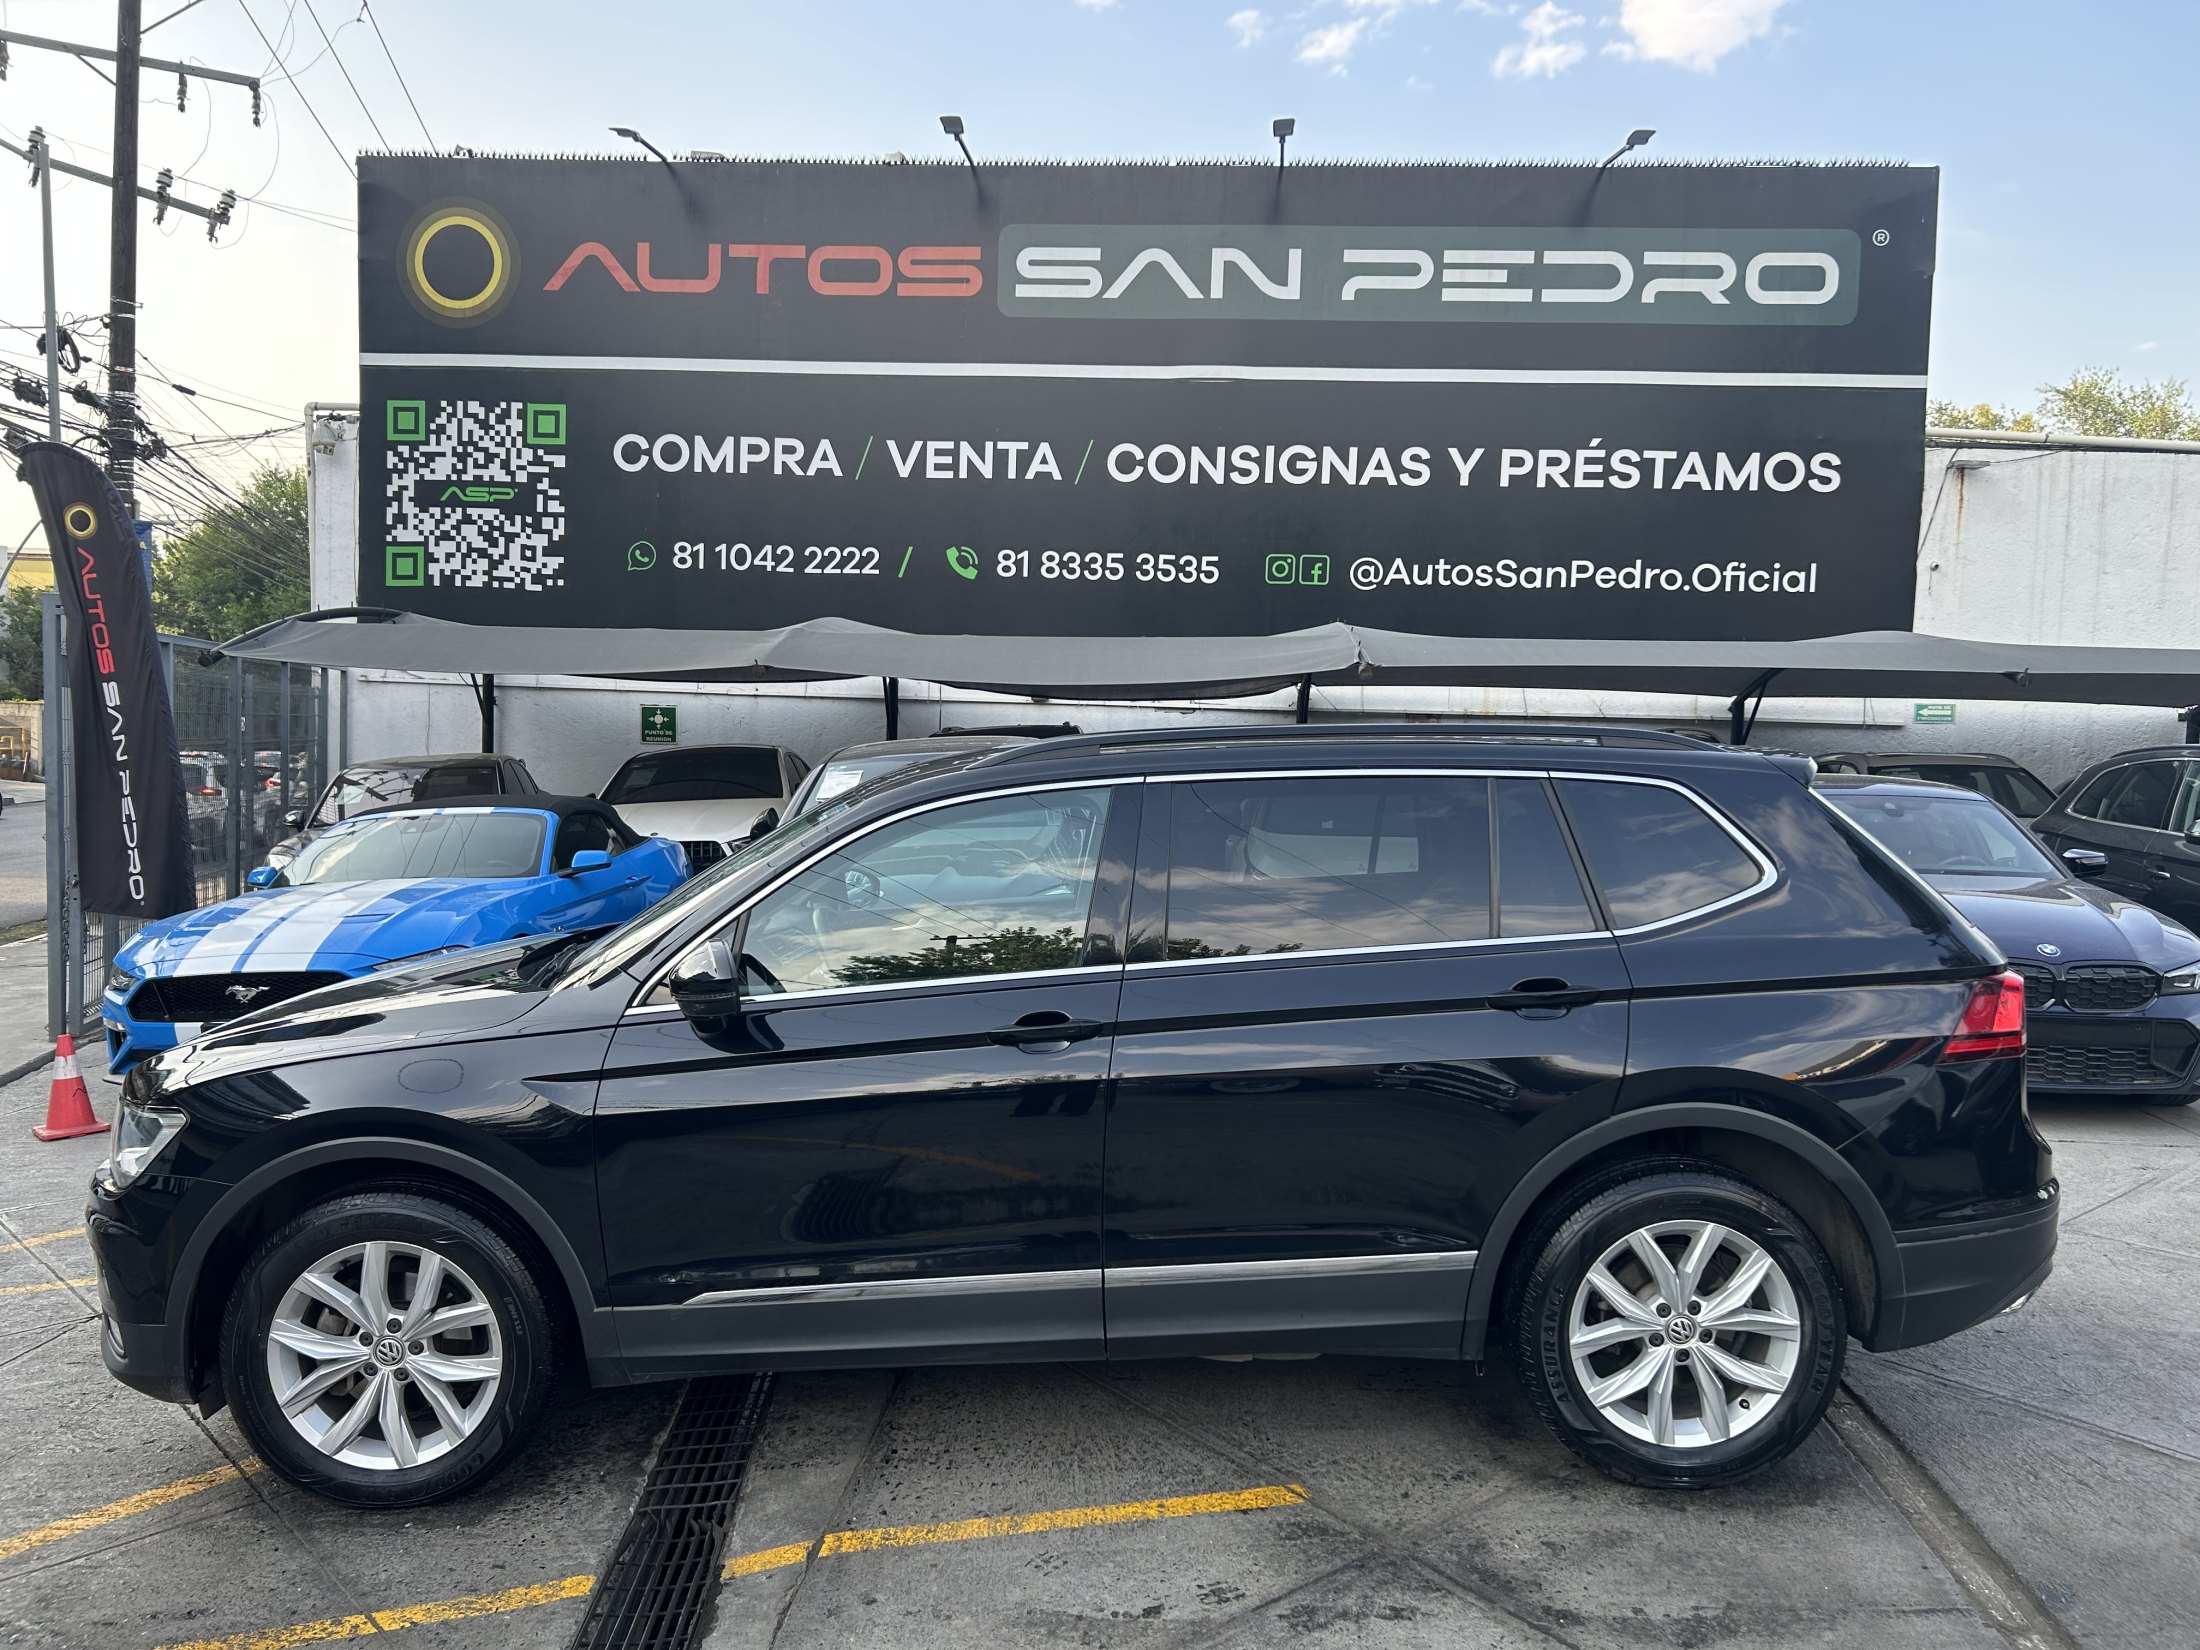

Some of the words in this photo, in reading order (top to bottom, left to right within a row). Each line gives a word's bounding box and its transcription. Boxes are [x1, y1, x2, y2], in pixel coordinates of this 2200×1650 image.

[543, 241, 984, 297] AUTOS
[1015, 246, 1303, 300] SAN
[1341, 249, 1840, 305] PEDRO
[613, 433, 844, 477] COMPRA
[885, 439, 1063, 481] VENTA
[1106, 442, 1431, 487] CONSIGNAS
[1447, 447, 1486, 487] Y
[1499, 437, 1842, 493] PRÉSTAMOS
[672, 541, 705, 570] 81
[714, 543, 795, 573] 1042
[804, 546, 880, 575] 2222
[996, 549, 1029, 578] 81
[1040, 550, 1125, 581] 8335
[1135, 552, 1220, 584] 3535
[1349, 557, 1817, 593] @AutosSanPedro.Oficial
[77, 547, 116, 674] AUTOS
[102, 681, 128, 761] SAN
[119, 770, 145, 901] PEDRO
